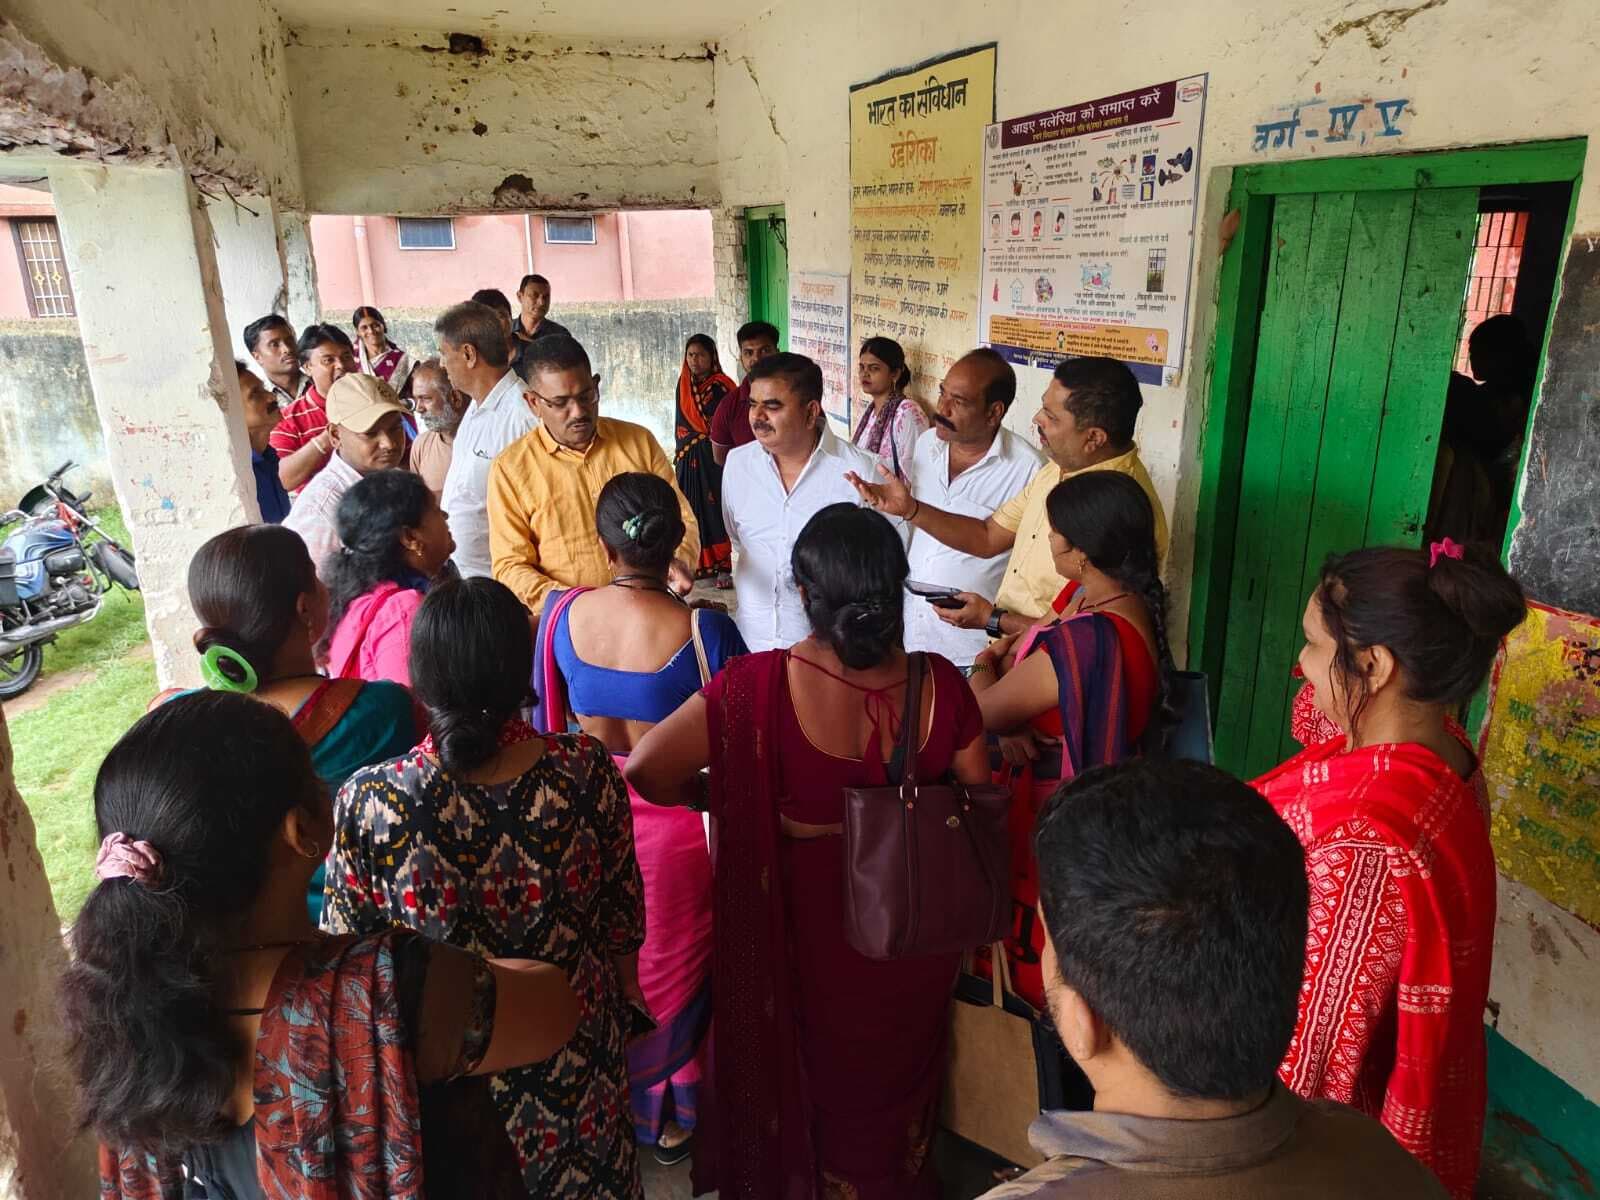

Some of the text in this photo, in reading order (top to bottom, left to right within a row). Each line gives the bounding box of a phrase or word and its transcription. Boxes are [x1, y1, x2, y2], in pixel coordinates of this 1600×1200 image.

[867, 75, 968, 127] भारत का संविधान
[1011, 121, 1035, 136] आइए
[1039, 110, 1076, 129] मलेरिया
[1080, 104, 1095, 120] को
[1099, 99, 1135, 116] समाप्त
[1139, 90, 1161, 107] करें
